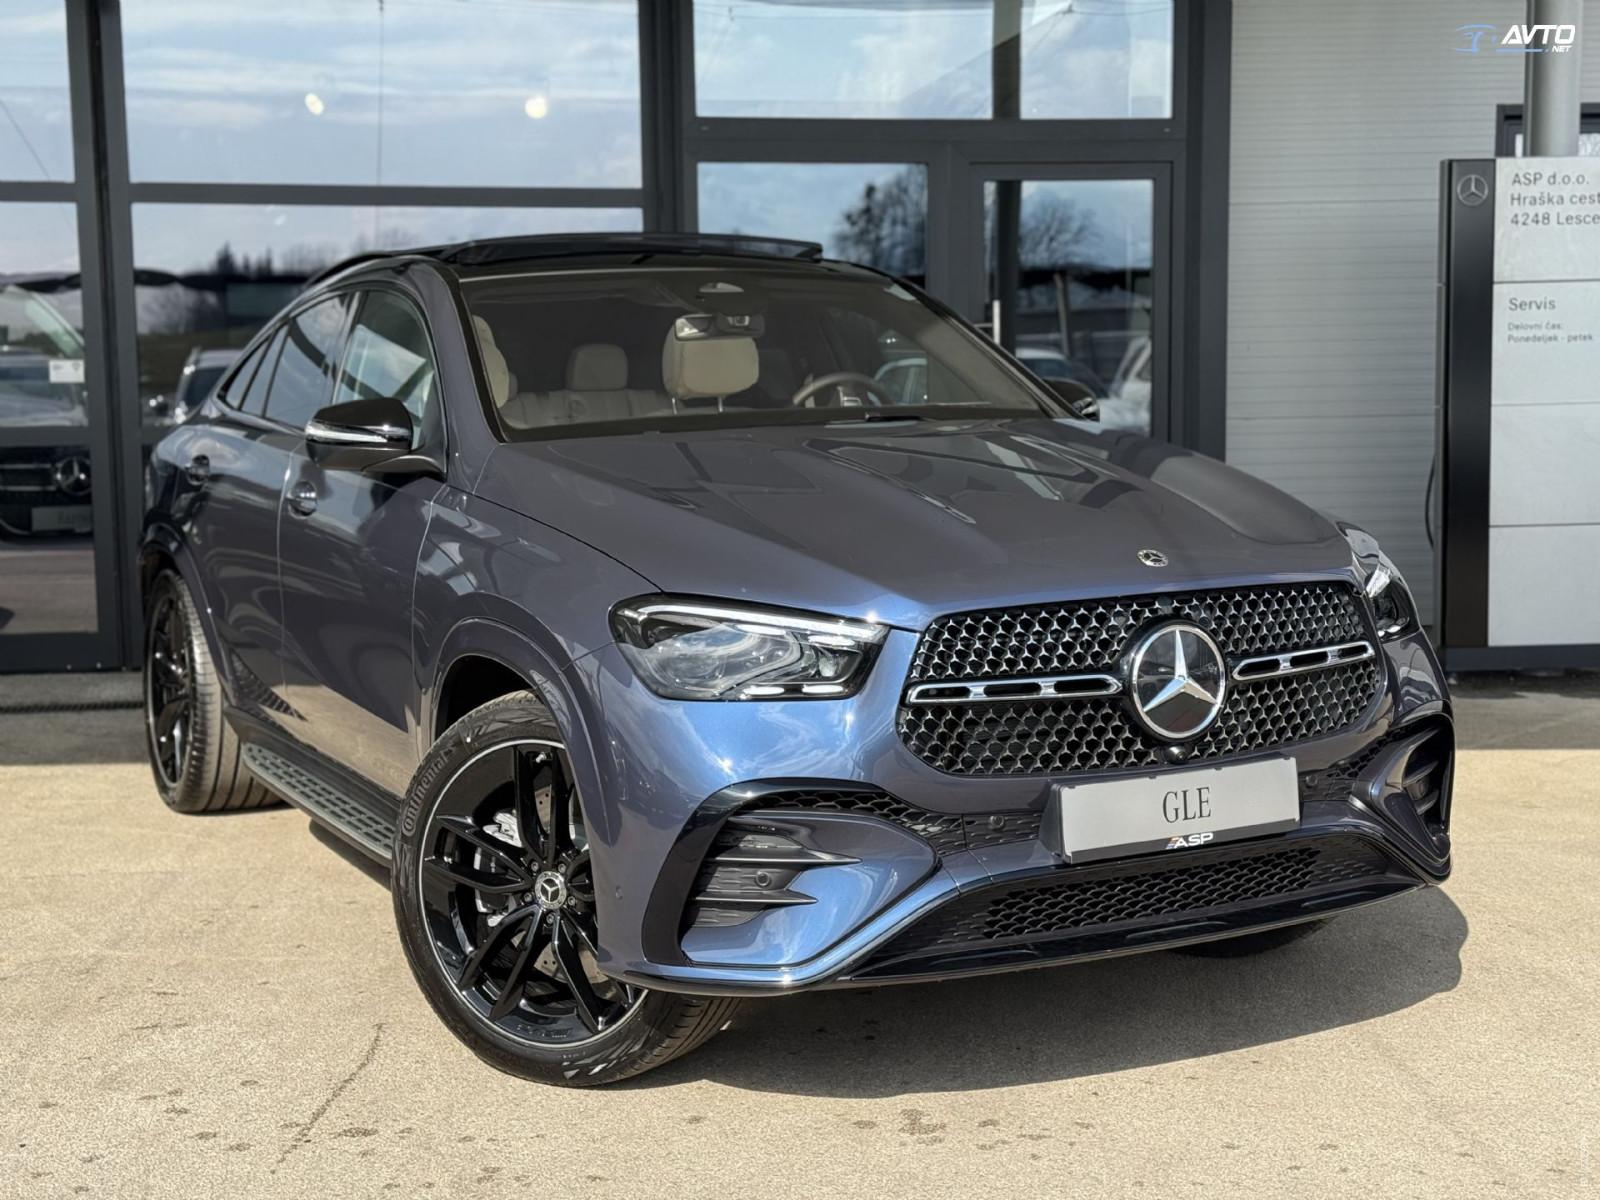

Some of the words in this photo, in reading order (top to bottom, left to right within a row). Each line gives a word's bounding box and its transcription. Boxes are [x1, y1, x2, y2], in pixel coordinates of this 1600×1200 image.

[1511, 172, 1544, 186] ASP
[1547, 171, 1590, 185] d.o.o.
[1510, 192, 1564, 206] Hraška
[1510, 212, 1551, 226] 4248
[1557, 212, 1600, 225] Lesce
[1508, 297, 1556, 311] Servis
[402, 749, 451, 837] Continental
[1162, 786, 1211, 824] GLE
[1173, 831, 1214, 849] ASP
